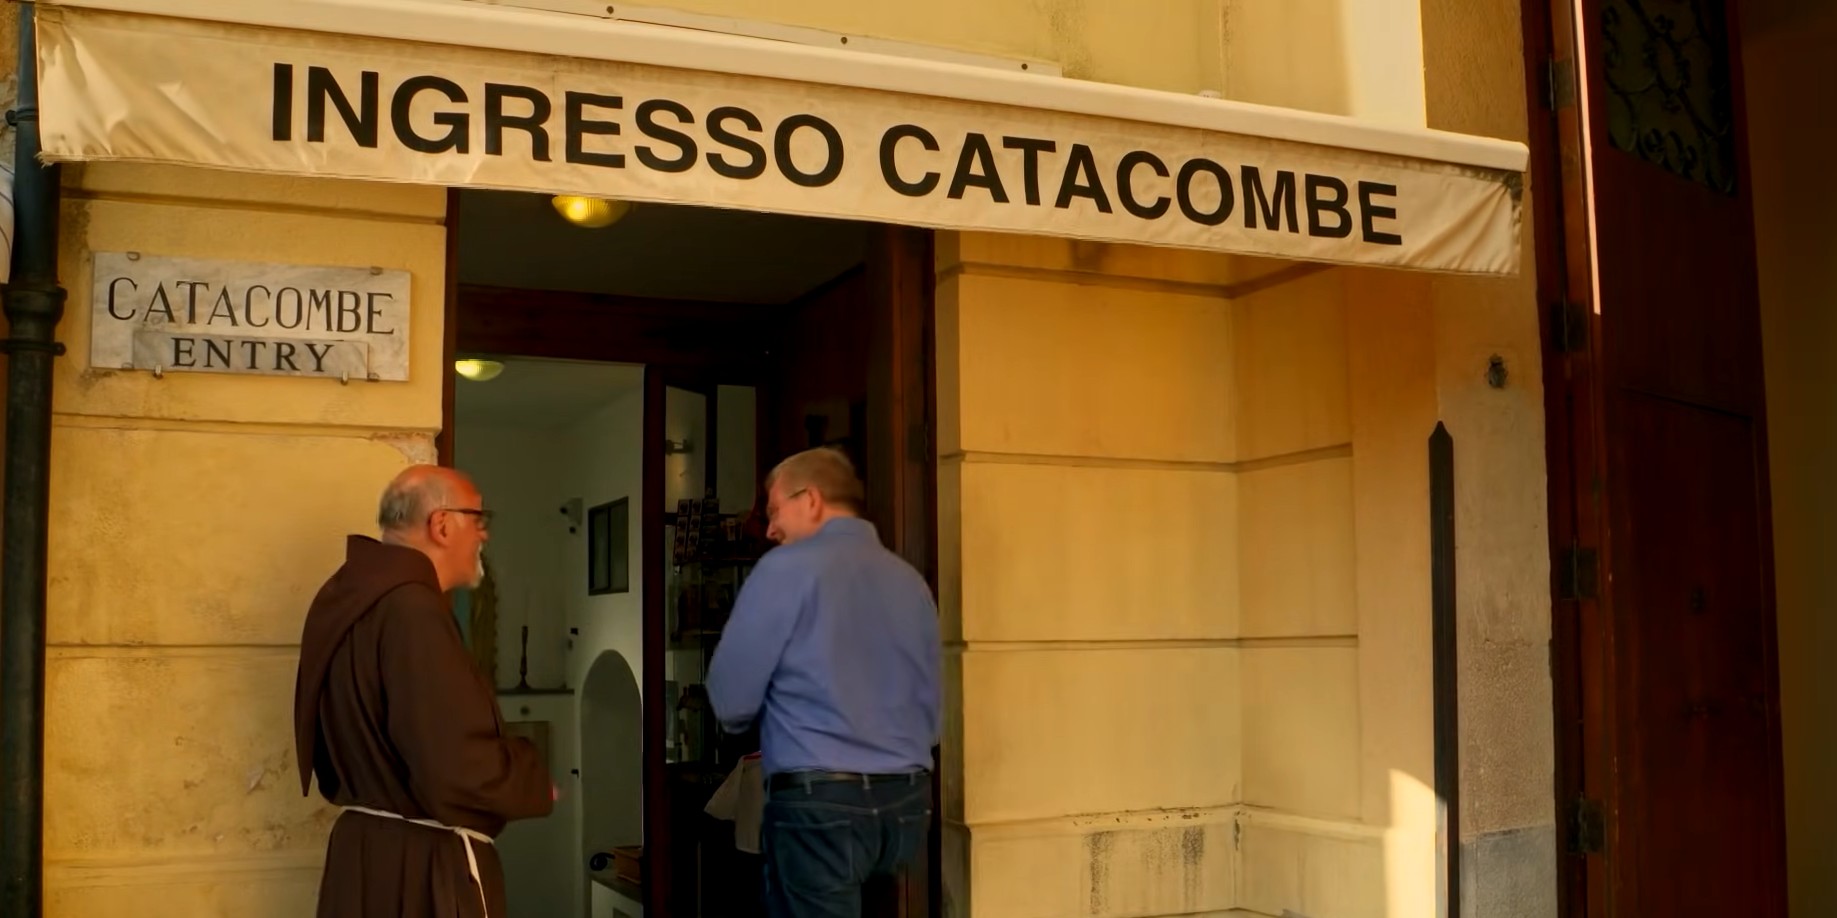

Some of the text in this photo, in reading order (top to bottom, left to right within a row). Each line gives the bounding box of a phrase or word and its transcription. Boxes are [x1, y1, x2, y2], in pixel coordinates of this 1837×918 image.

[271, 61, 1404, 247] INGRESSO CATACOMBE
[107, 276, 395, 336] CATACOMBE
[170, 336, 335, 373] ENTRY
